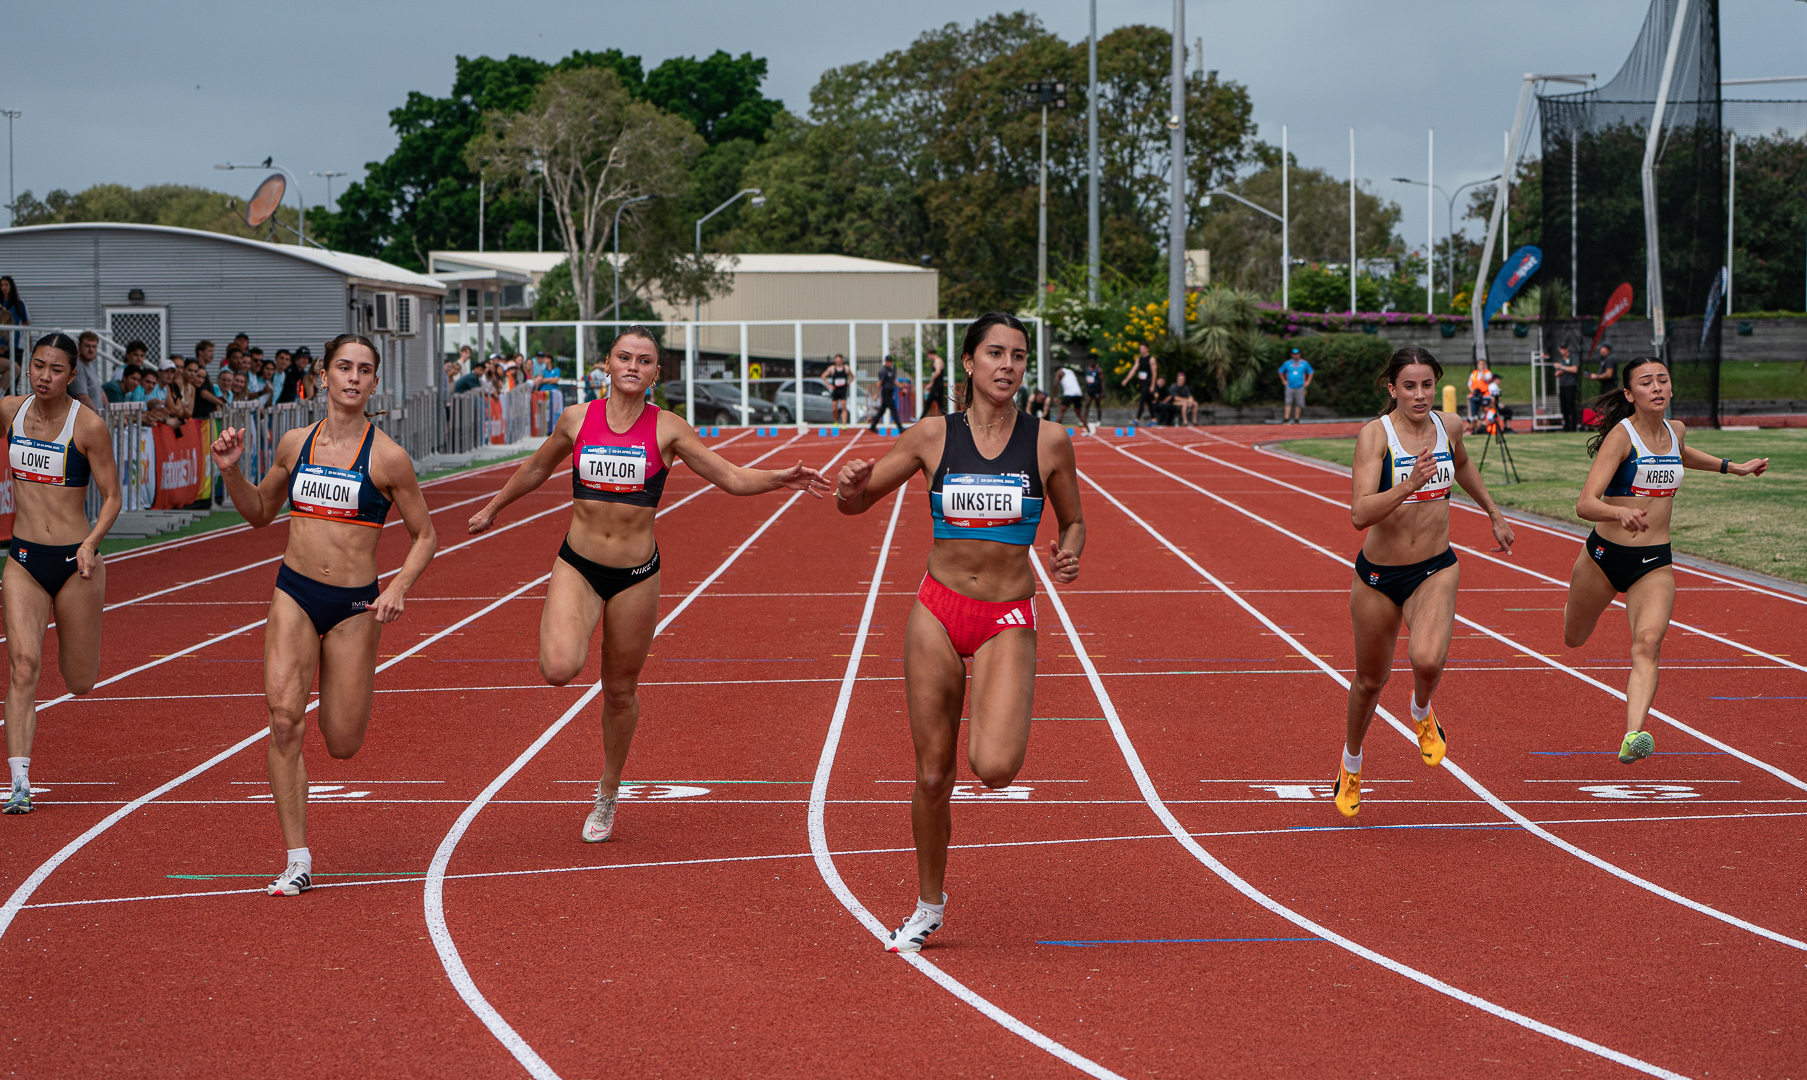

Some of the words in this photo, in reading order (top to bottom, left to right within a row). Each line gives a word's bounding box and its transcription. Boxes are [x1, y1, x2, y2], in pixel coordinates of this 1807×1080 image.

[21, 451, 50, 470] LOWE
[589, 460, 636, 479] TAYLOR
[1645, 469, 1675, 484] KREBS
[300, 480, 350, 503] HANLON
[951, 492, 1012, 512] INKSTER
[631, 562, 651, 576] NIKE
